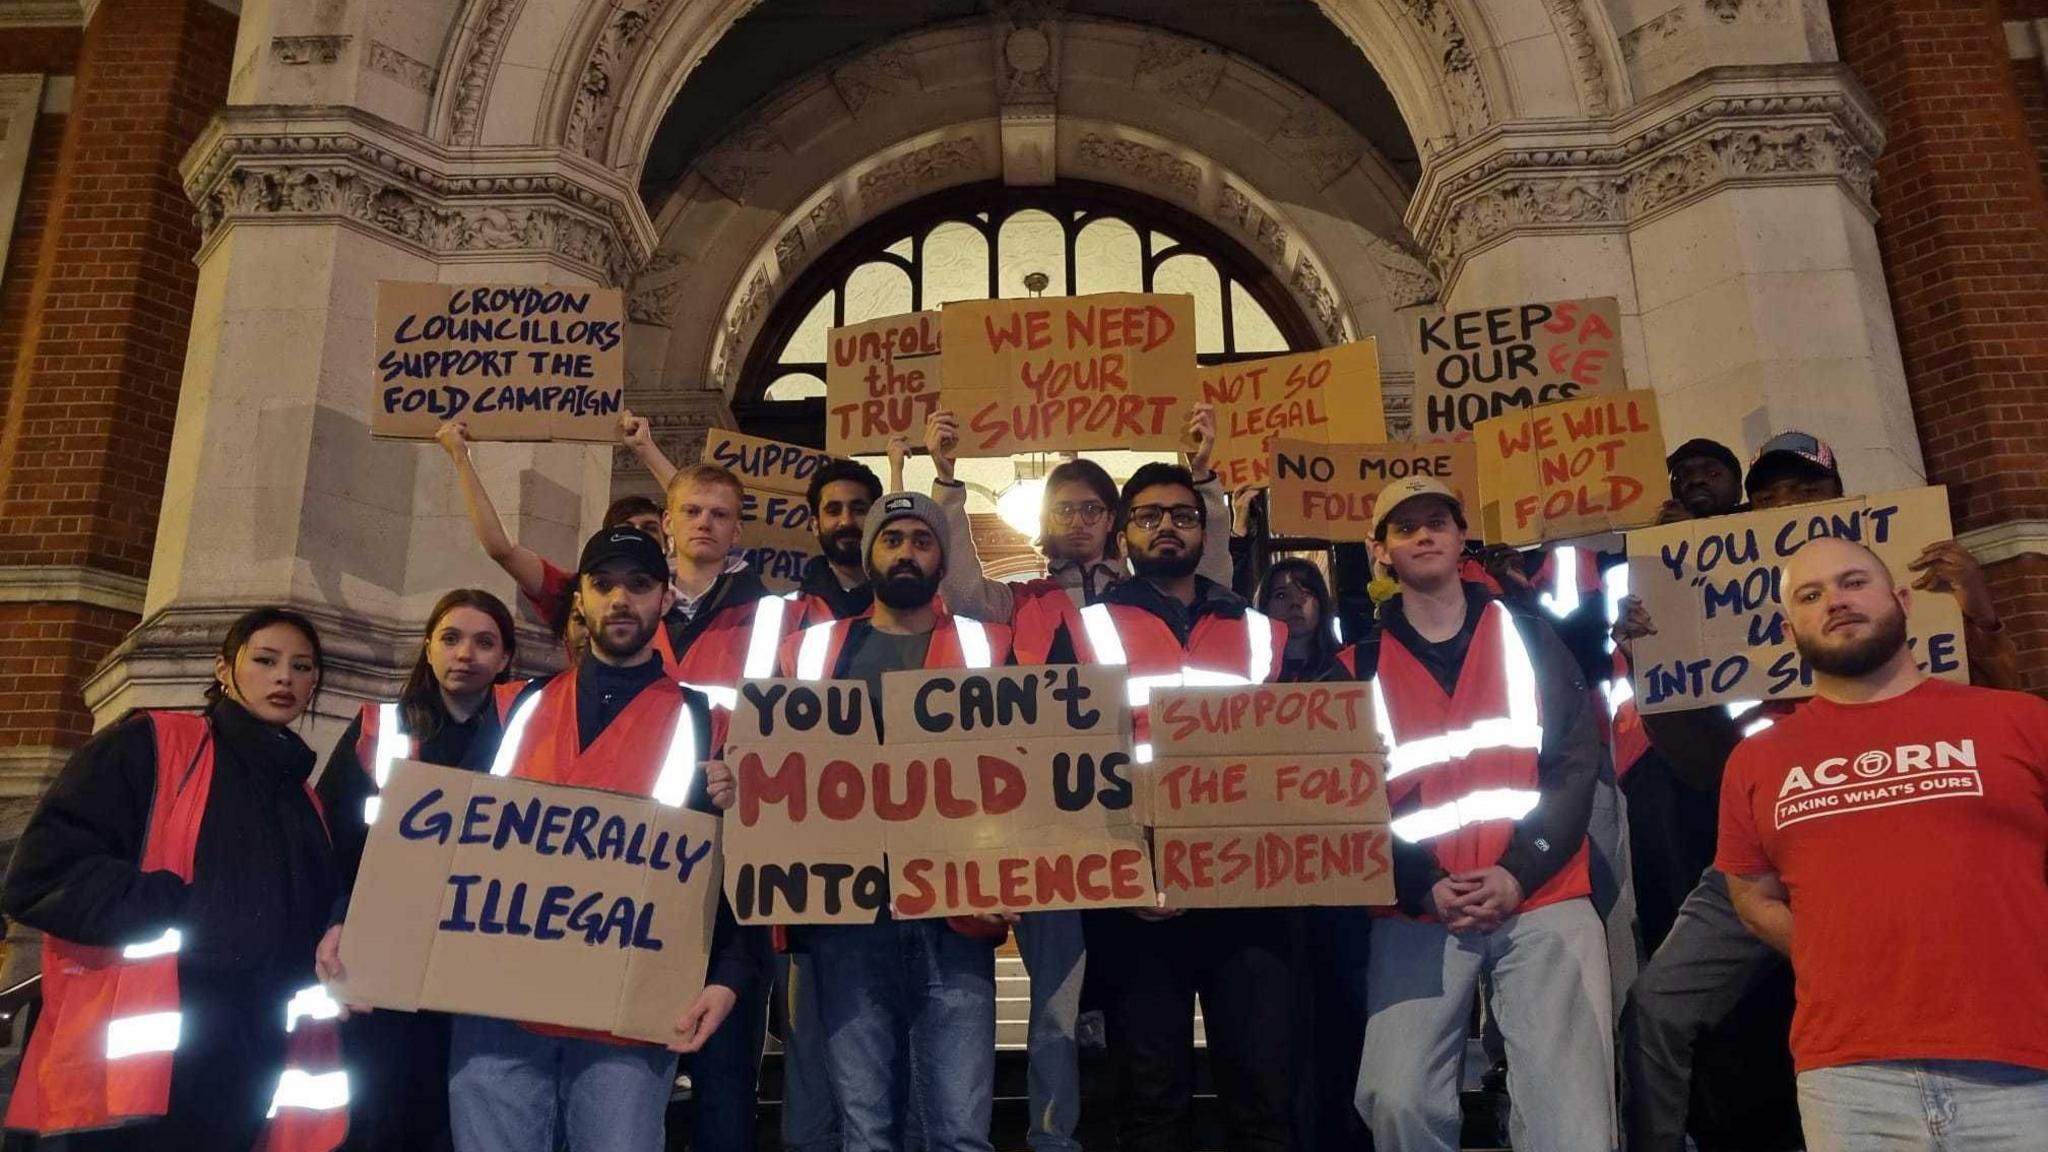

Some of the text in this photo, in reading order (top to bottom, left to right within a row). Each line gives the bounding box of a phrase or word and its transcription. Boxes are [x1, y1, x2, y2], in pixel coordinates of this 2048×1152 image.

[448, 287, 590, 317] CROYDON
[394, 314, 621, 351] COUNCILLORS
[984, 305, 1176, 354] WE NEED
[1419, 304, 1552, 354] KEEP
[378, 350, 594, 382] SUPPORT THE
[863, 364, 925, 398] the
[1020, 353, 1128, 403] YOUR
[1202, 359, 1332, 404] NOT SO
[1437, 344, 1538, 389] OUR
[383, 385, 623, 419] FOLD CAMPAIGN
[831, 391, 940, 440] TRUT
[969, 394, 1178, 450] SUPPORT
[1231, 399, 1329, 438] LEGAL
[1498, 401, 1649, 459] WE WILL
[713, 440, 832, 479] SUPPO
[1277, 453, 1452, 482] NO MORE
[1542, 439, 1626, 486] NOT
[1514, 475, 1644, 529] FOLD
[1661, 529, 1759, 580] YOU
[1644, 656, 1748, 704] INTO
[742, 683, 862, 736] YOU
[1162, 688, 1365, 741] SUPPORT
[1052, 752, 1133, 812] US
[1158, 758, 1380, 810] THE FOLD
[1778, 739, 1977, 798] ACORN
[1779, 776, 1973, 819] TAKING WHAT'S OURS
[399, 788, 712, 883] GENERALLY
[736, 849, 1144, 920] INTO SILENCE
[1163, 831, 1390, 890] RESIDENTS
[438, 875, 663, 951] ILLEGAL
